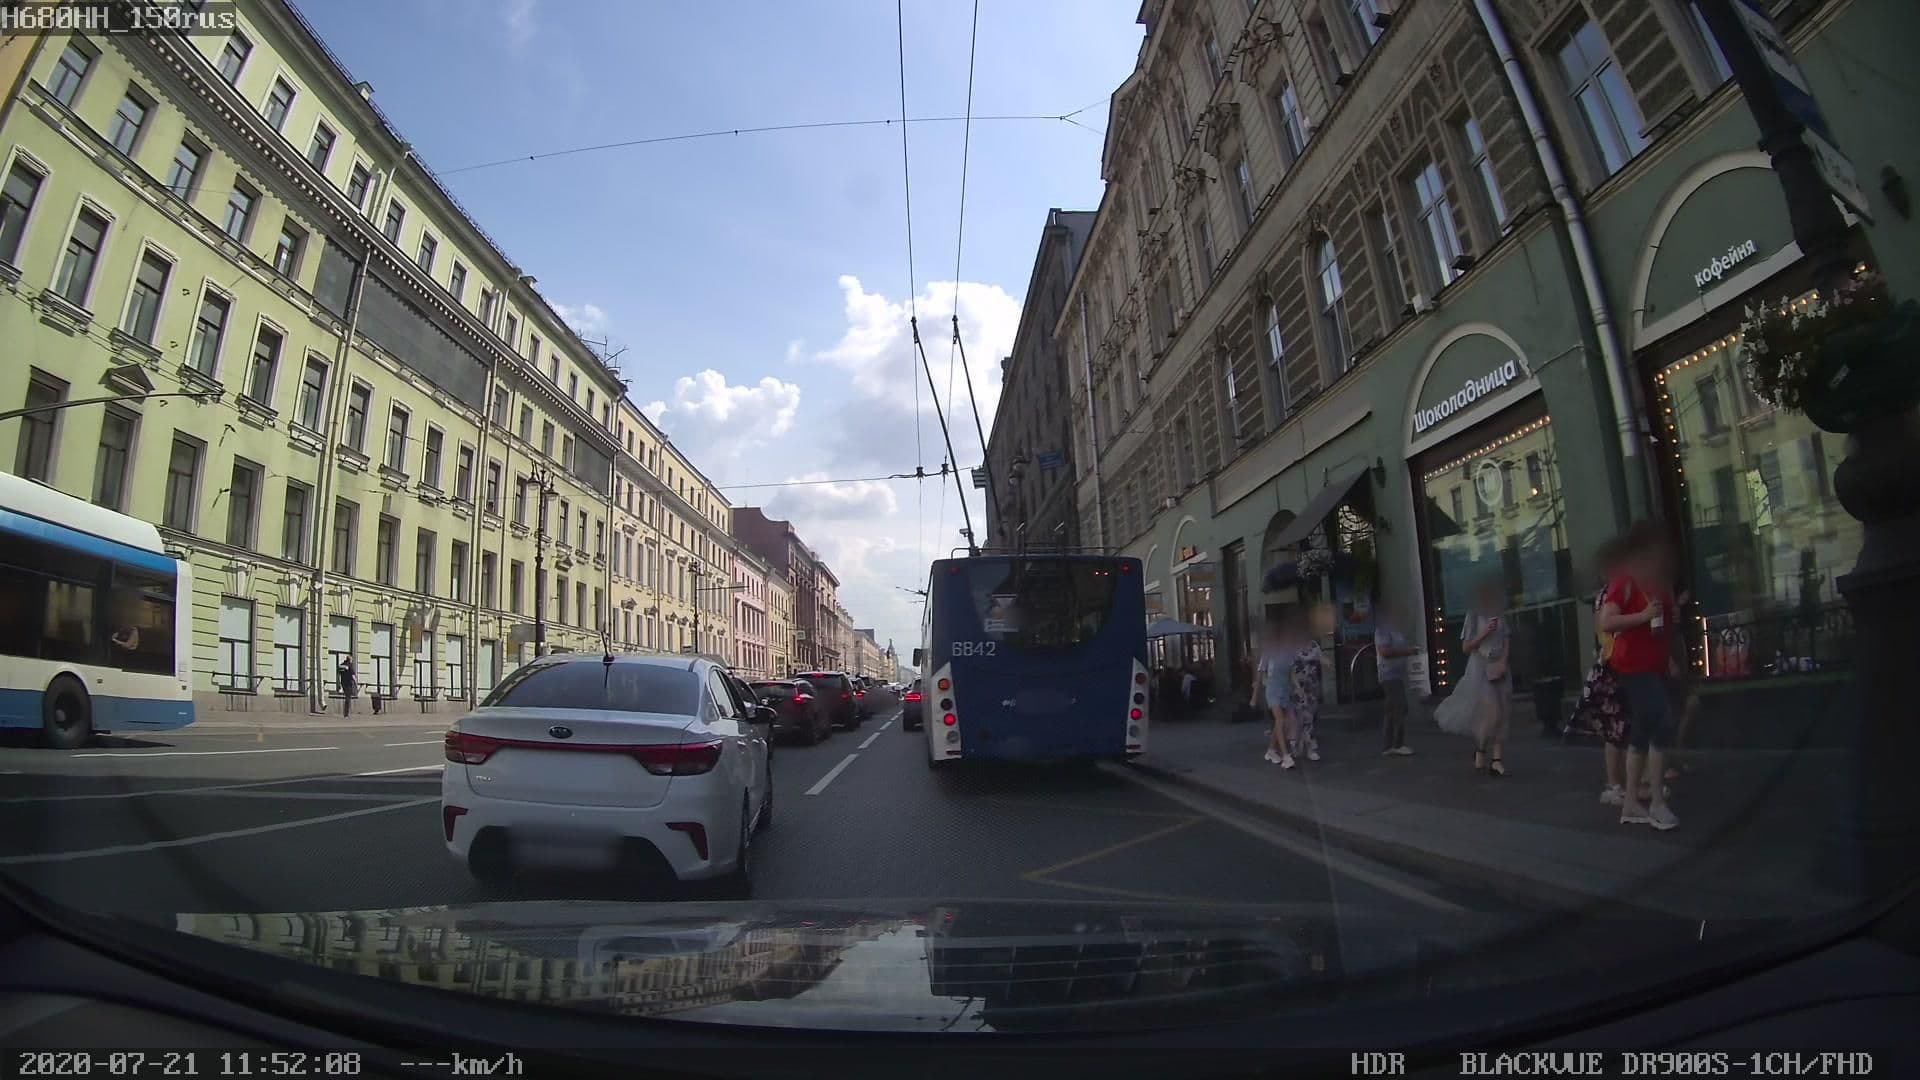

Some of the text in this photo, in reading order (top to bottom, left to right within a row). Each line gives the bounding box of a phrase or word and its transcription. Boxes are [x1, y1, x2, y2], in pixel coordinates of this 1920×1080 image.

[1694, 239, 1756, 288] кофейня
[1414, 359, 1517, 433] Шоколадница
[951, 641, 996, 657] 6842
